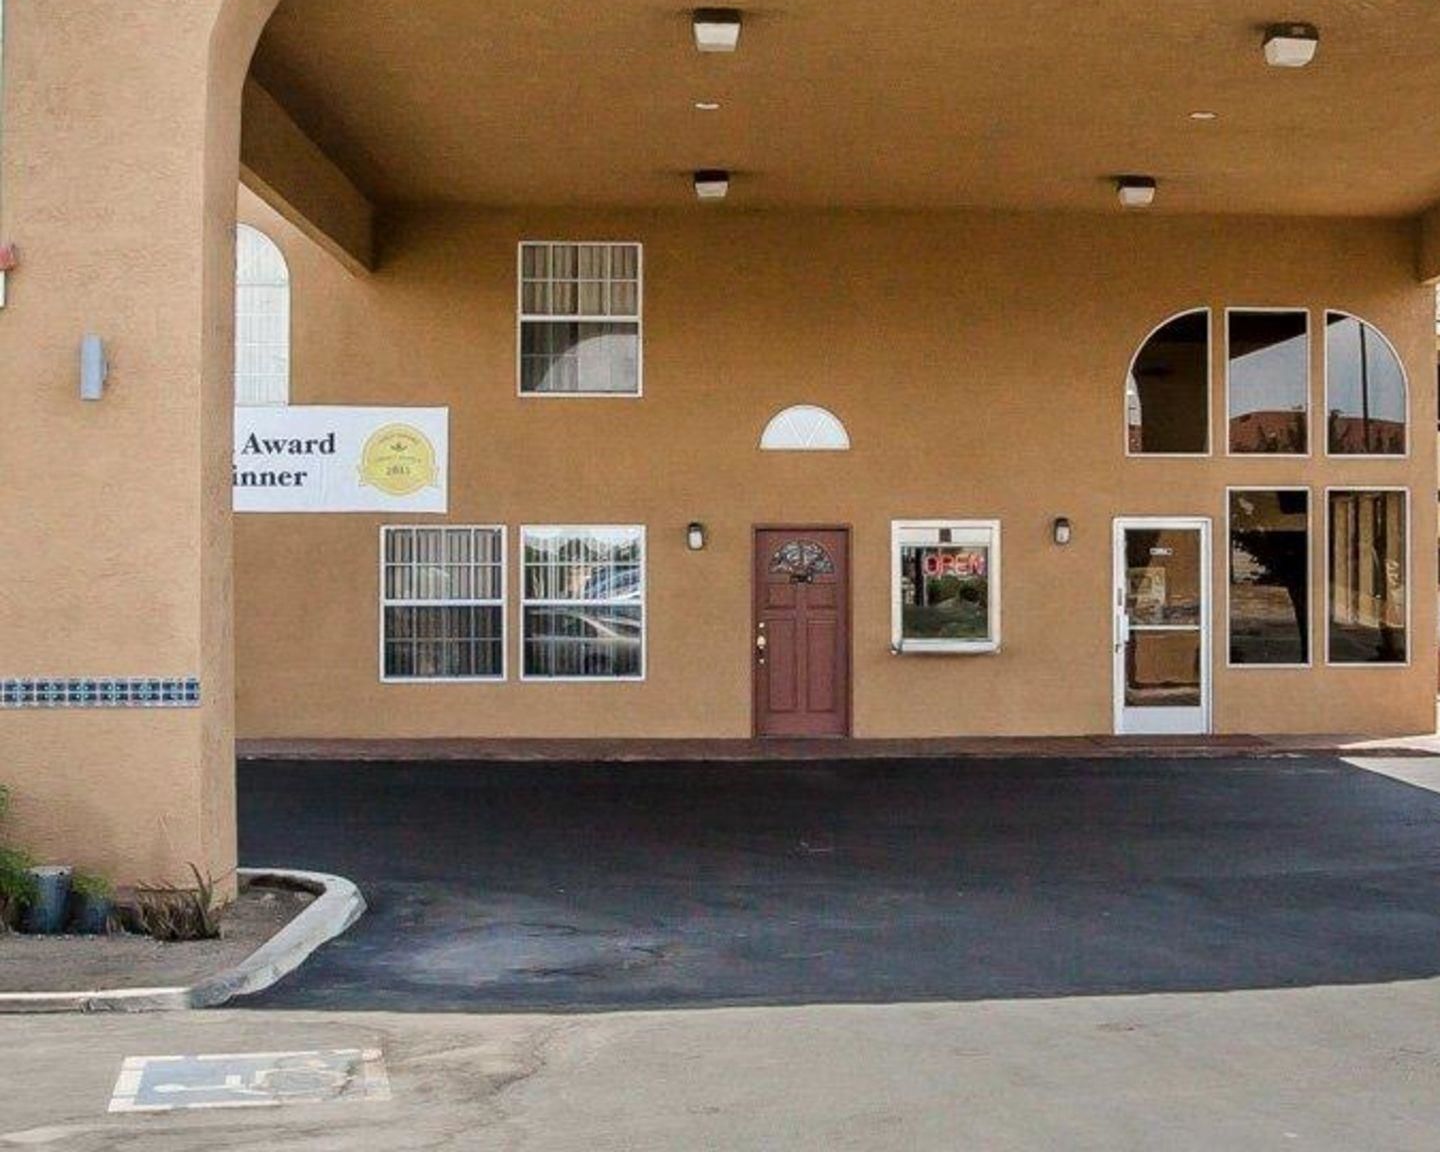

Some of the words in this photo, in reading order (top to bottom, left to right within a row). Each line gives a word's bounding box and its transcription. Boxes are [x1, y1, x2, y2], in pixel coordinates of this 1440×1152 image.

[241, 432, 336, 455] Award
[231, 464, 308, 487] inner
[922, 552, 986, 575] OPEN
